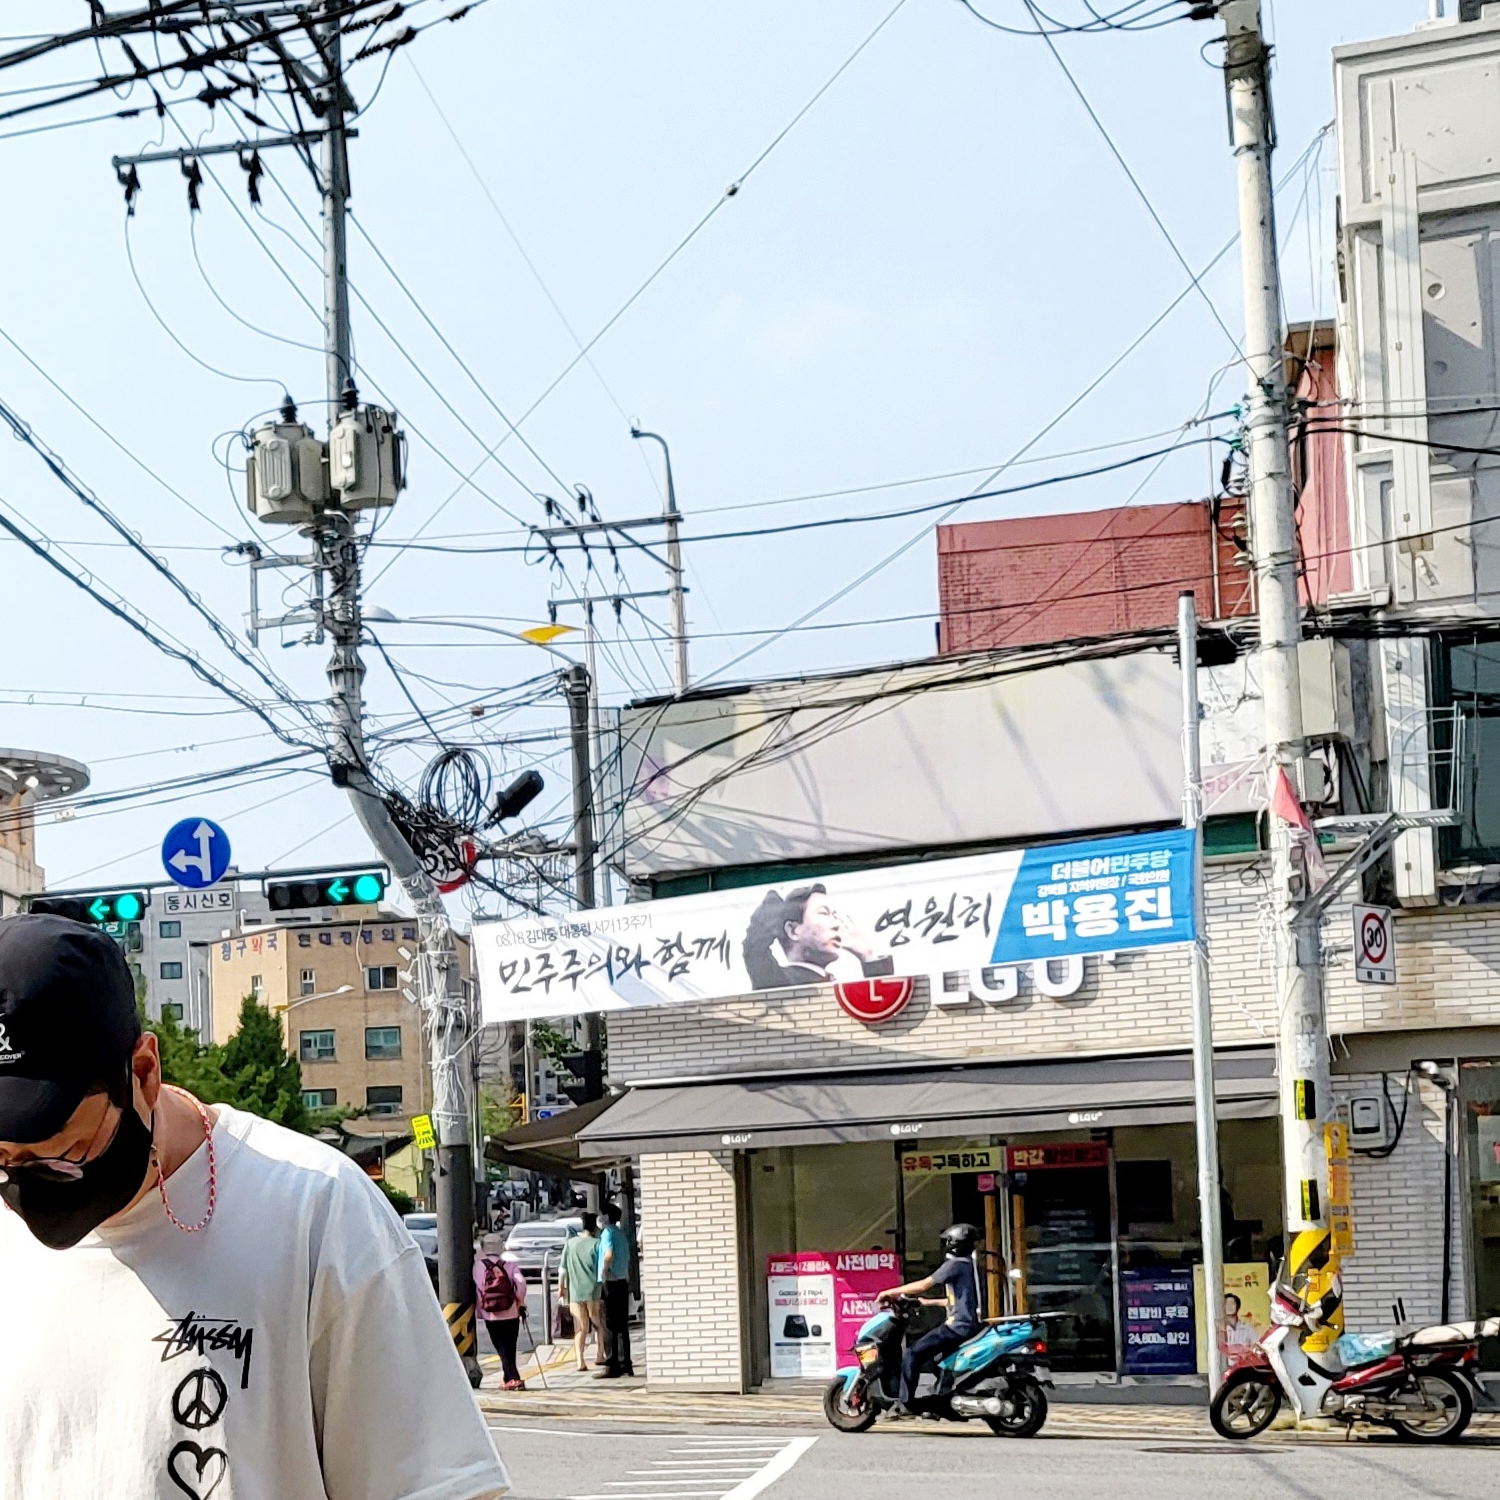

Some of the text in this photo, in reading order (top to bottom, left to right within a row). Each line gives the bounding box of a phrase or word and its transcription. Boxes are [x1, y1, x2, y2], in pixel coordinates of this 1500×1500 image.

[1051, 849, 1173, 881] 더불어민주당
[166, 892, 232, 911] 동시신호
[875, 892, 993, 947] 영원히
[1021, 885, 1174, 942] 박용진
[526, 926, 558, 944] 김대중
[1366, 926, 1383, 949] 30
[499, 929, 731, 995] 민주주의와 함께
[836, 1253, 895, 1272] 사전예약
[1127, 1305, 1189, 1320] 렌탈비 무료
